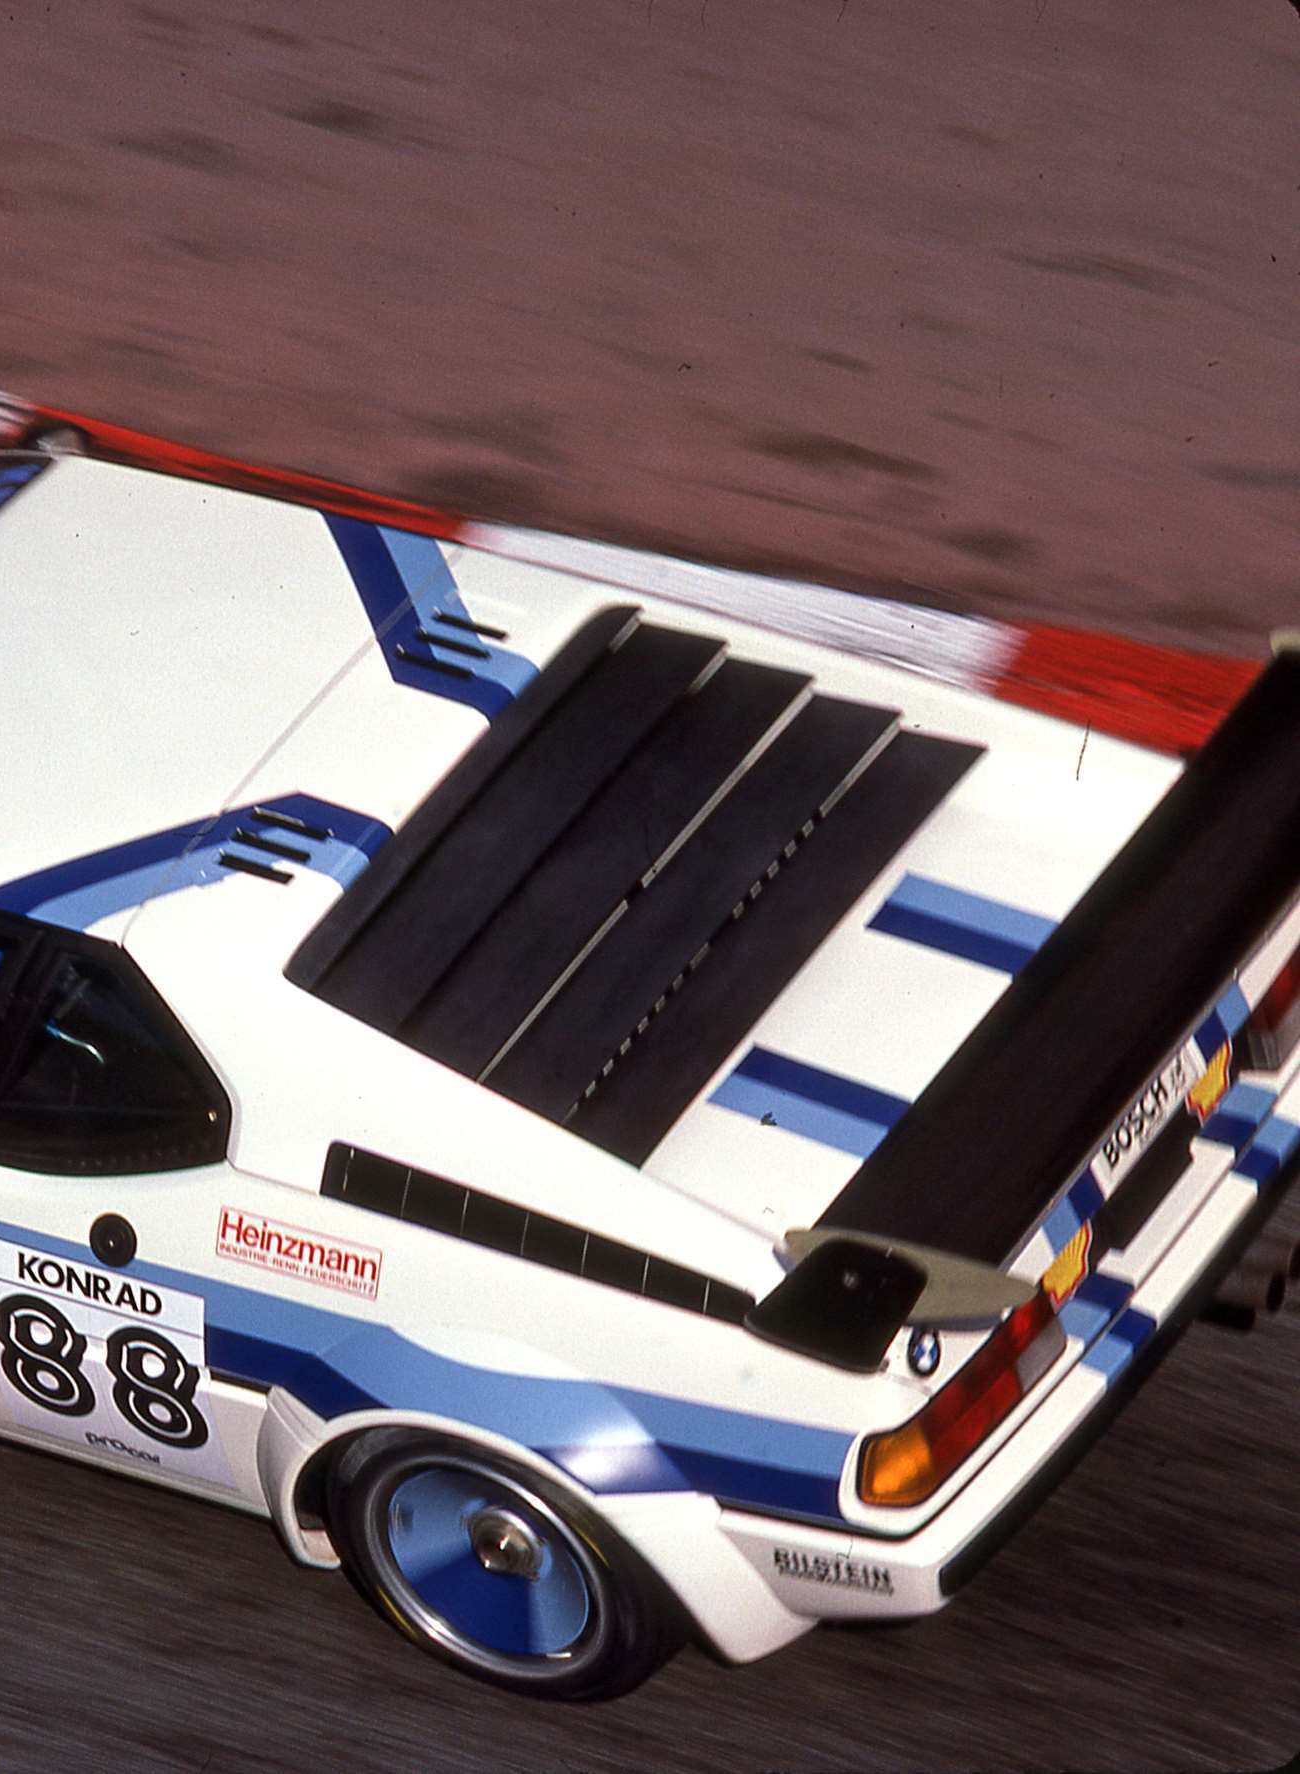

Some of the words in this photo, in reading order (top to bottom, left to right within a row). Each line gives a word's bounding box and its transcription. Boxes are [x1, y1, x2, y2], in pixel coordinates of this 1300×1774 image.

[1102, 1074, 1170, 1171] BOSCH
[221, 1211, 378, 1281] Heinzmann
[17, 1251, 163, 1317] KONRAD
